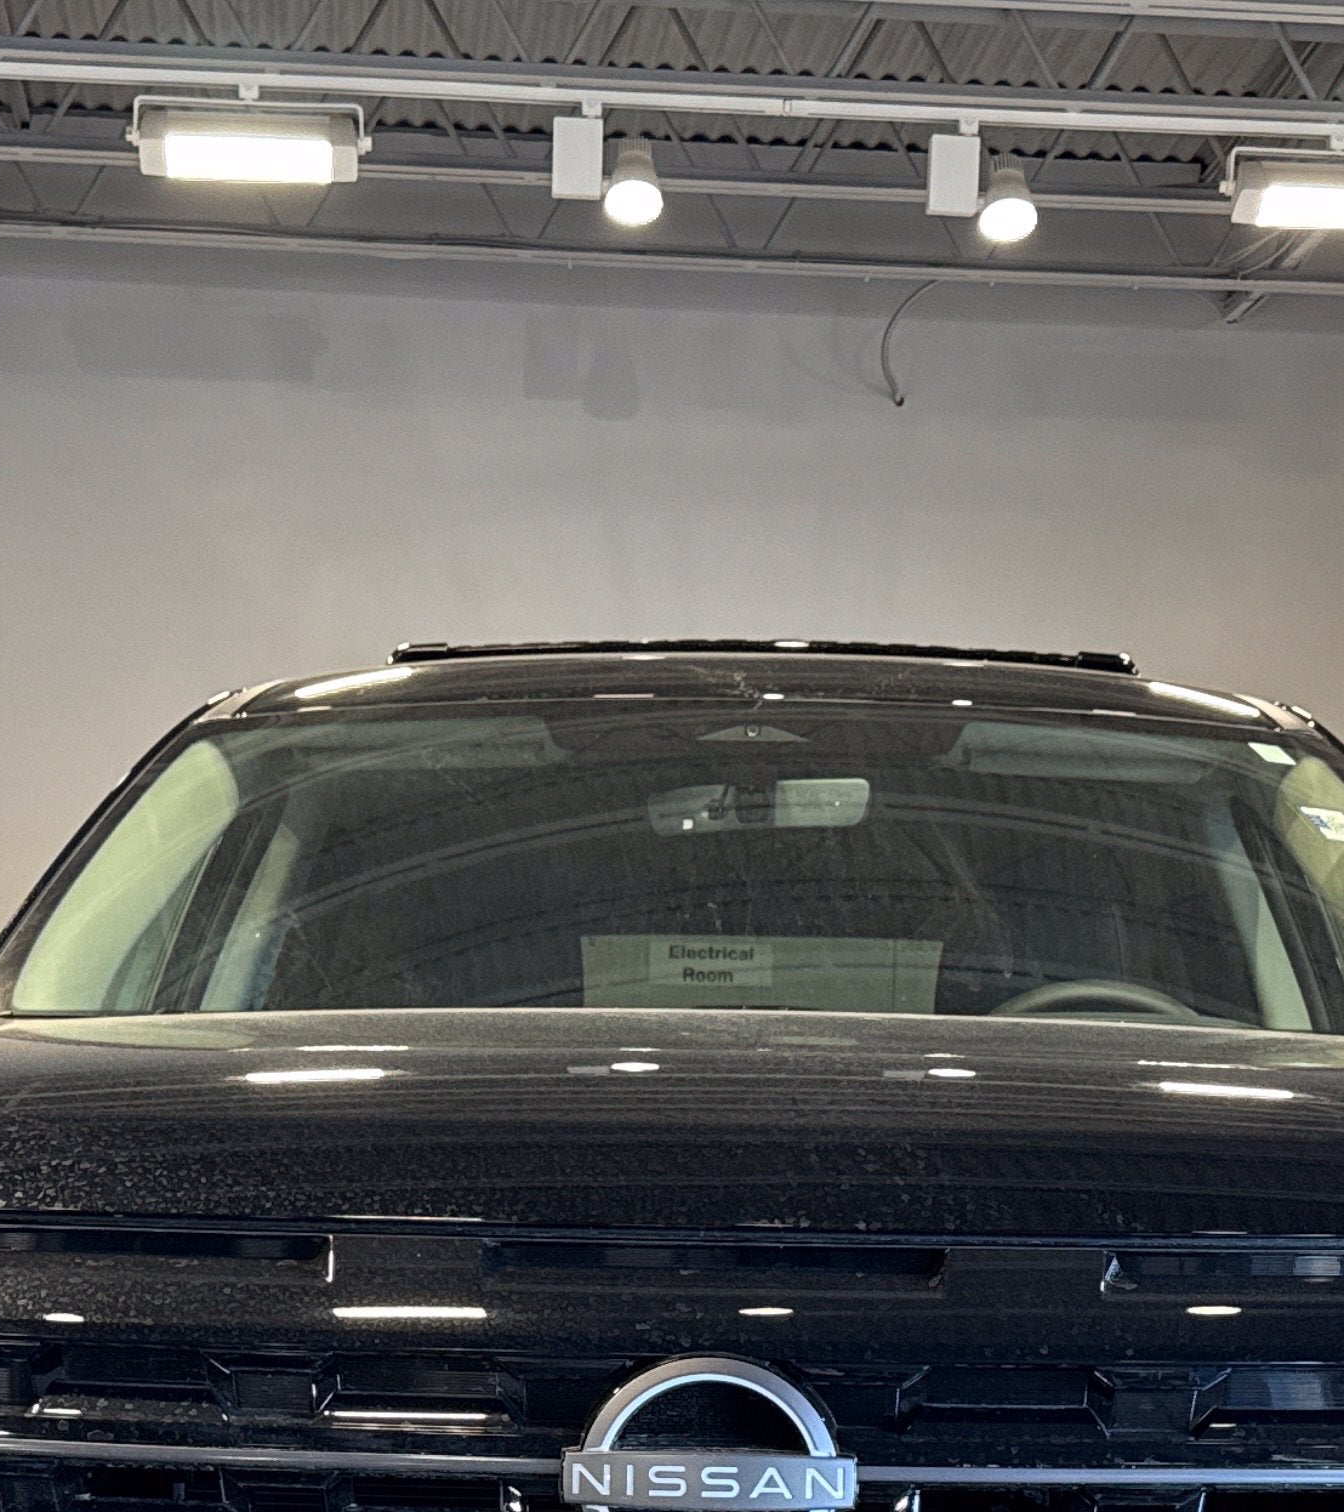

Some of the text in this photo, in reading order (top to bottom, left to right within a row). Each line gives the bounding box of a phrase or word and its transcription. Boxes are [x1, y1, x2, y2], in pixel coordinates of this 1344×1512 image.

[669, 945, 754, 962] Electrical
[682, 967, 733, 983] Room
[571, 1462, 844, 1499] NISSAN
